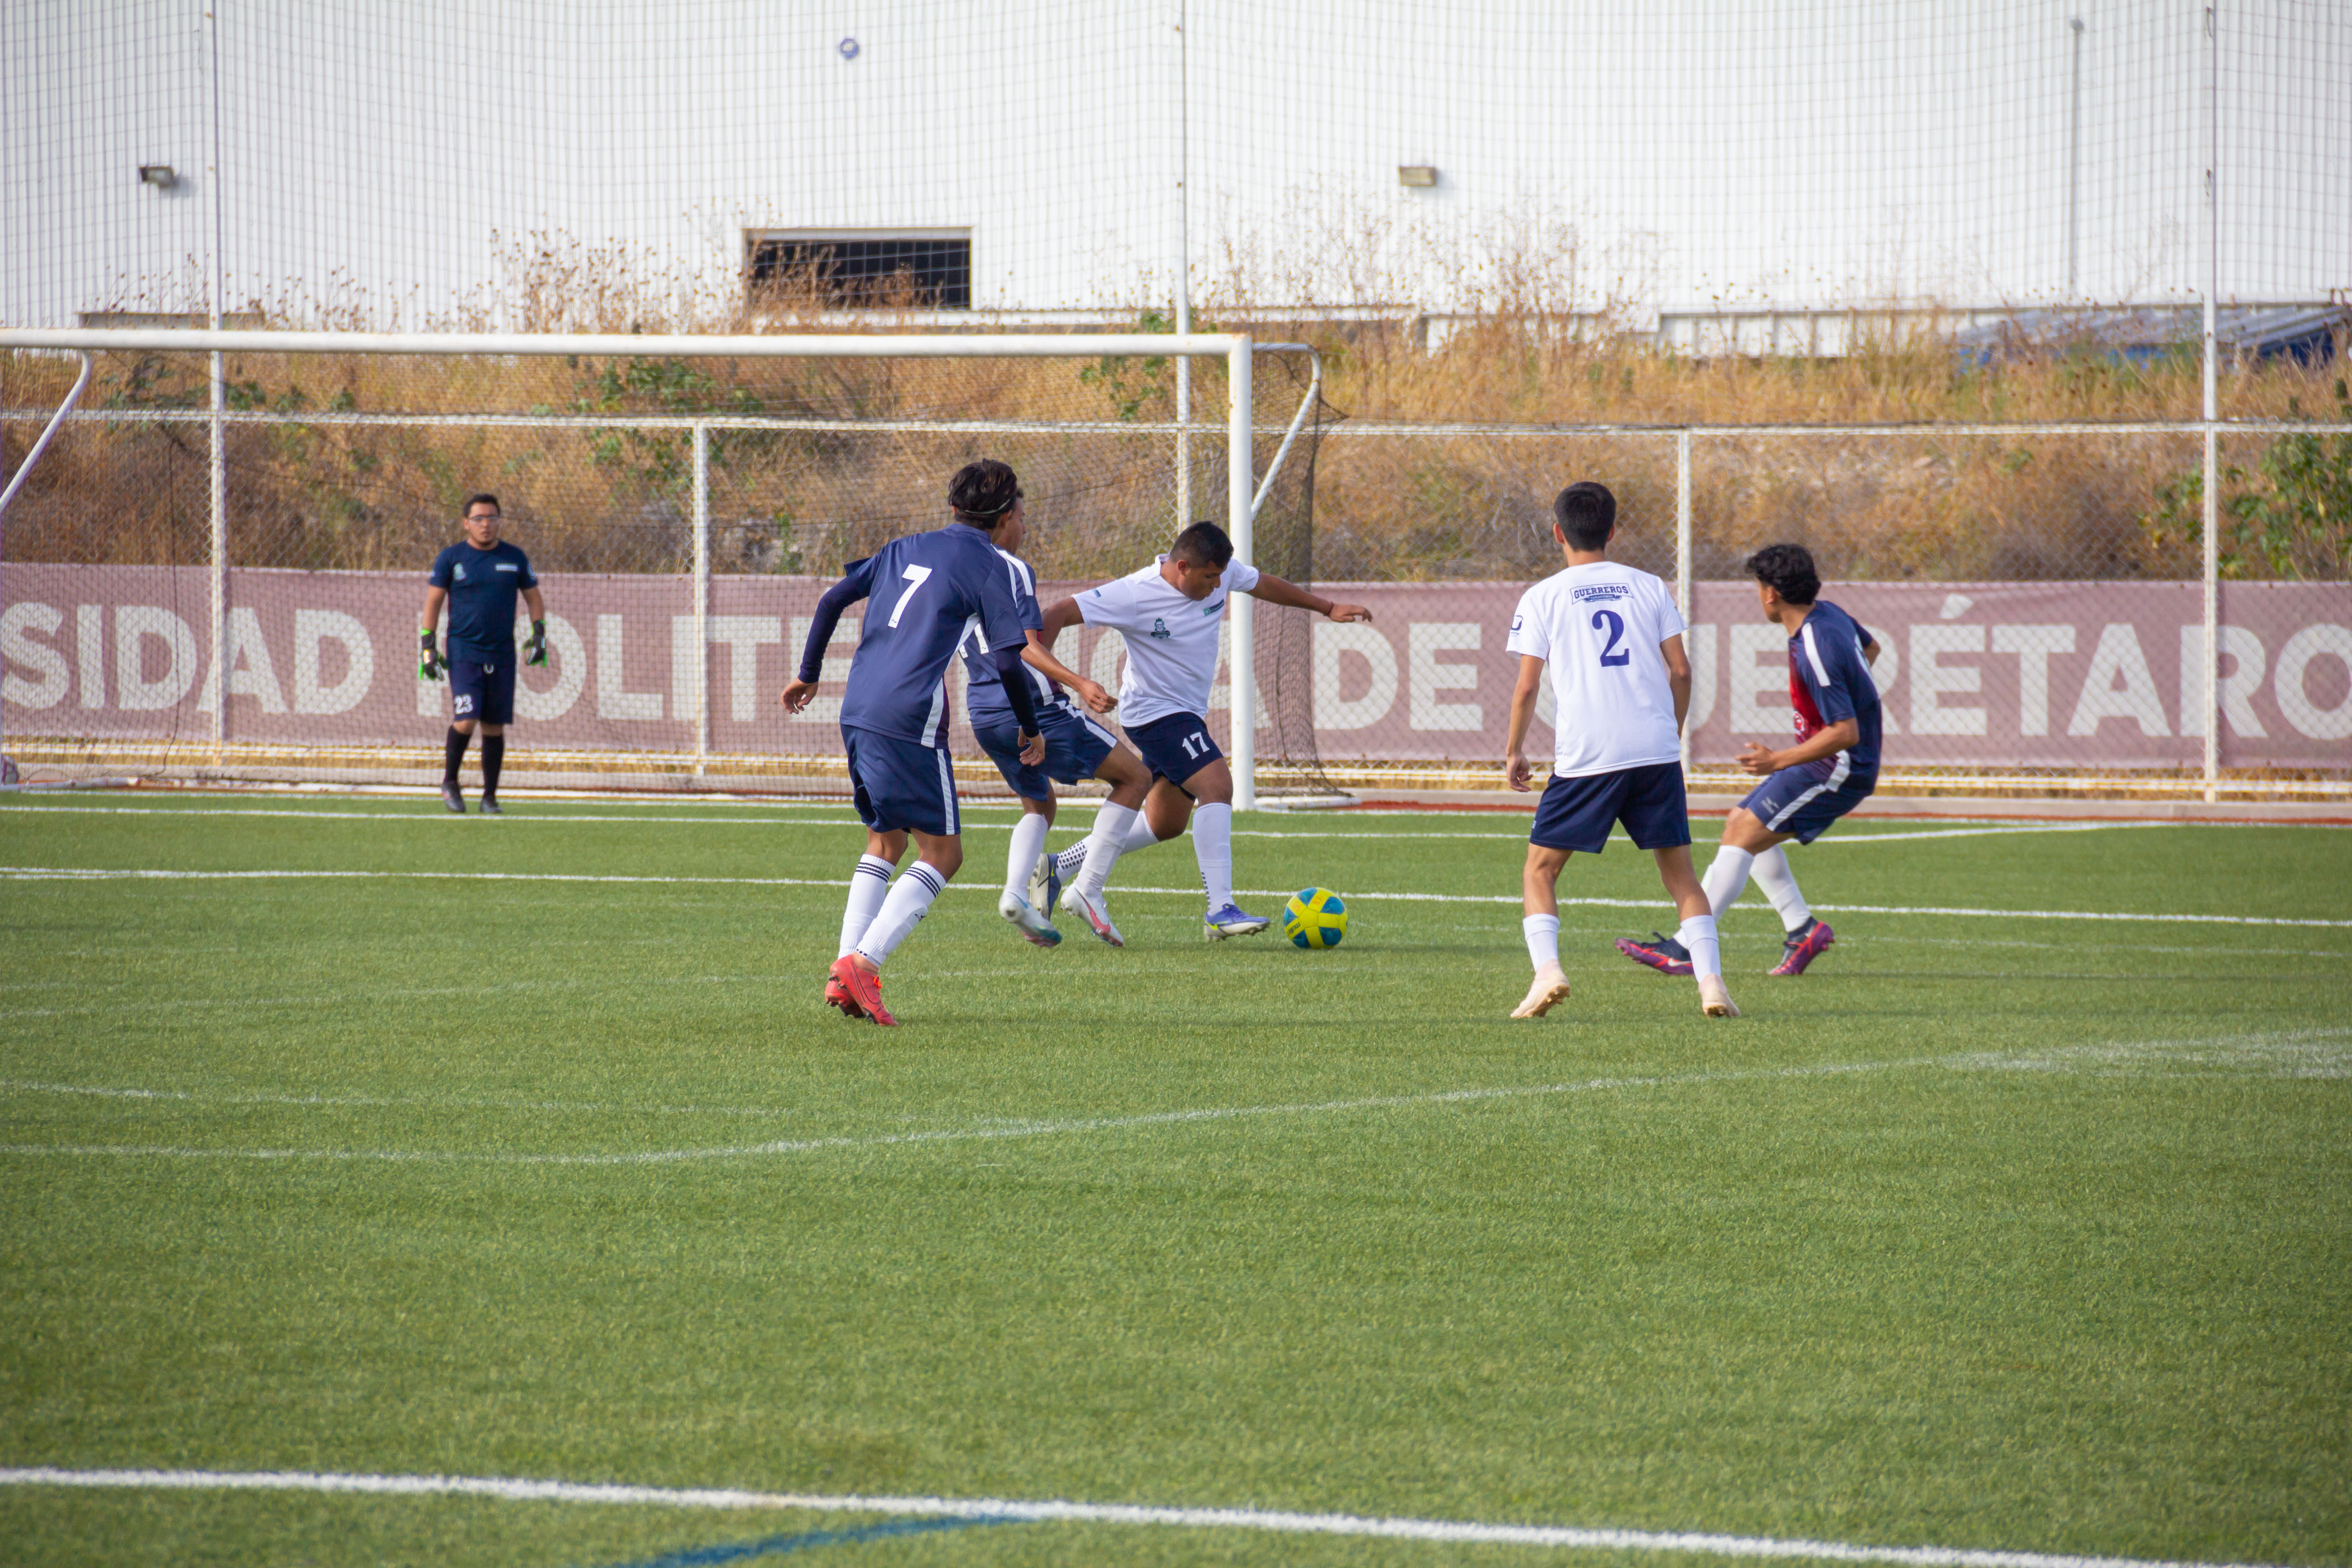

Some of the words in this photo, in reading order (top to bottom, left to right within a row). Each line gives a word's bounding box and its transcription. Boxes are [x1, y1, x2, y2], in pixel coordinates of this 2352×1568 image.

[888, 564, 932, 628] 7
[1574, 586, 1628, 599] GUERREROS
[1592, 610, 1630, 667] 2
[0, 602, 373, 715] SIDAD
[1315, 622, 1482, 730] DE
[455, 694, 473, 715] 23
[1181, 731, 1210, 760] 17
